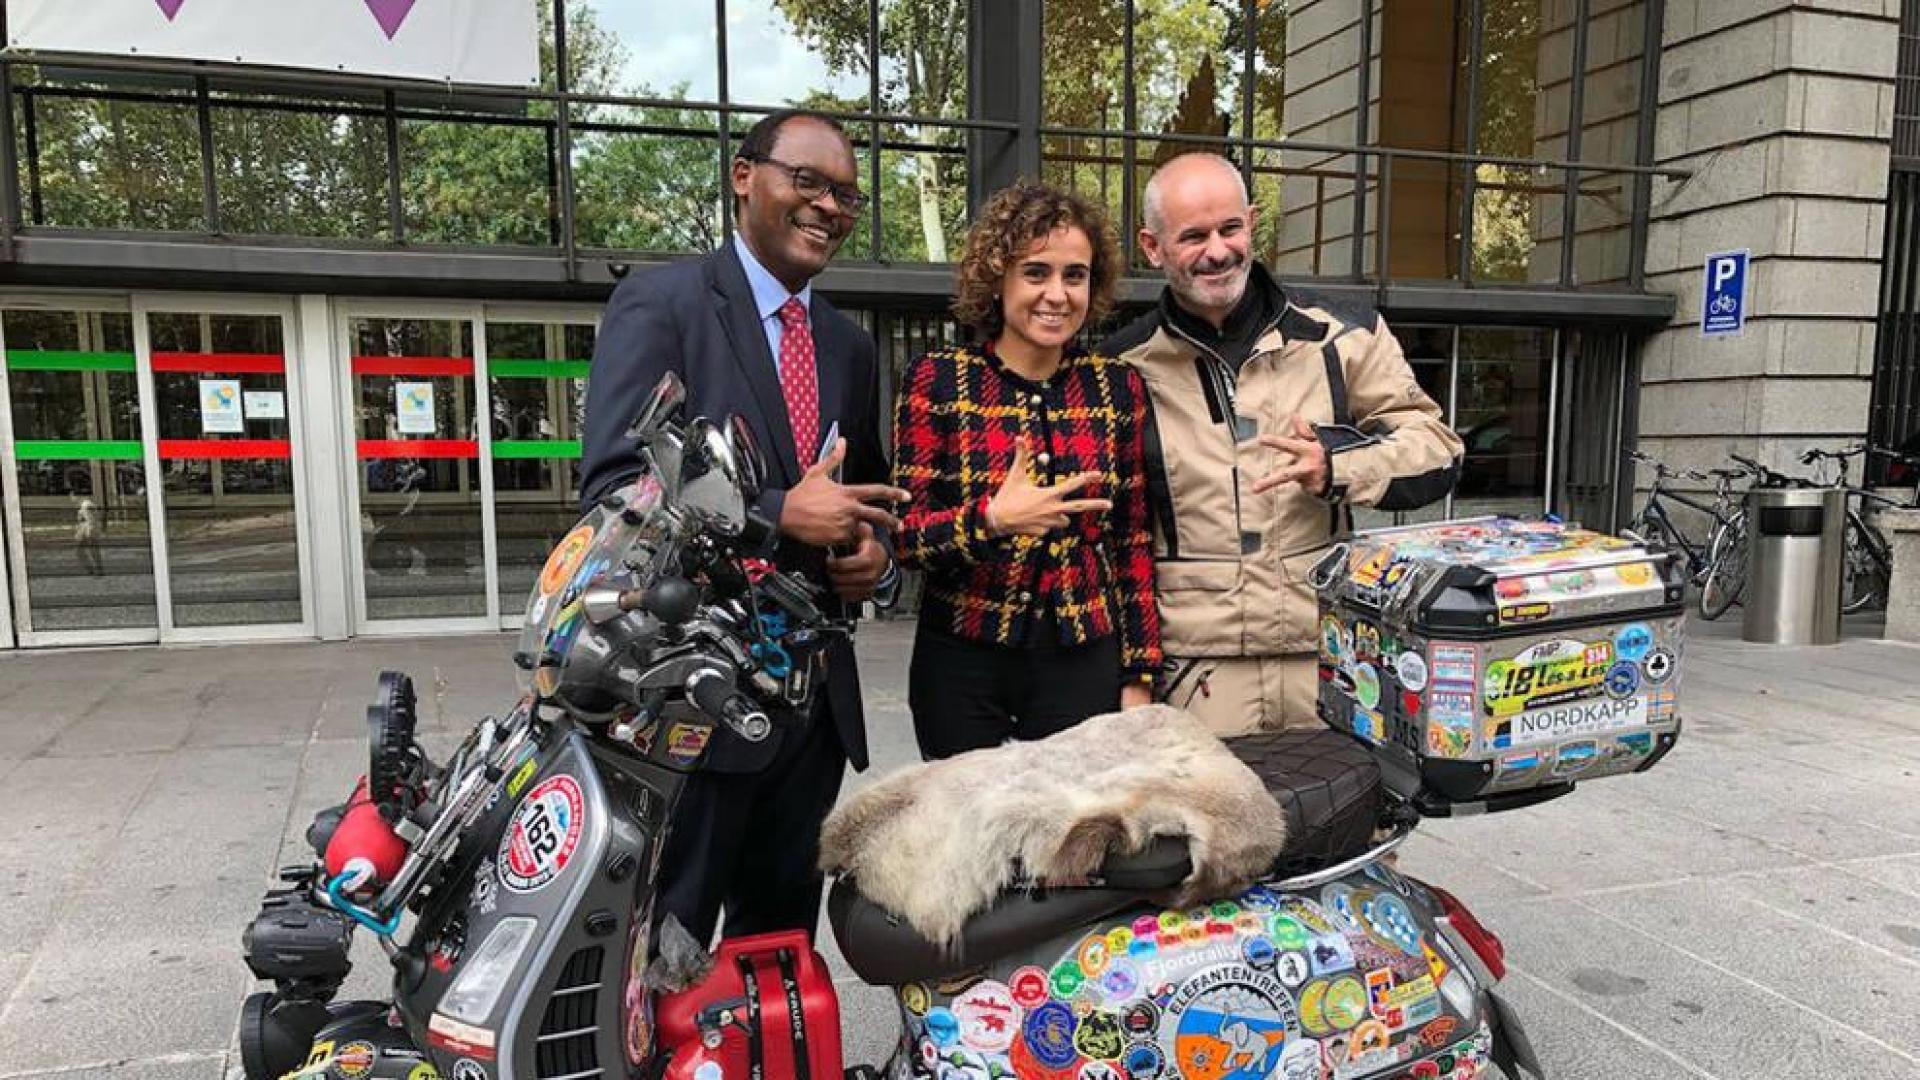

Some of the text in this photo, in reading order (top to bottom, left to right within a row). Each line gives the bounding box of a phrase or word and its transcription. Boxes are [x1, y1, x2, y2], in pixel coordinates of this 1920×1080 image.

[1714, 258, 1737, 292] P
[1521, 699, 1638, 732] NORDKAPP
[525, 803, 558, 864] 162
[1148, 942, 1237, 978] Fjordrally
[1169, 966, 1298, 1032] ELEFANTENTREFFEN
